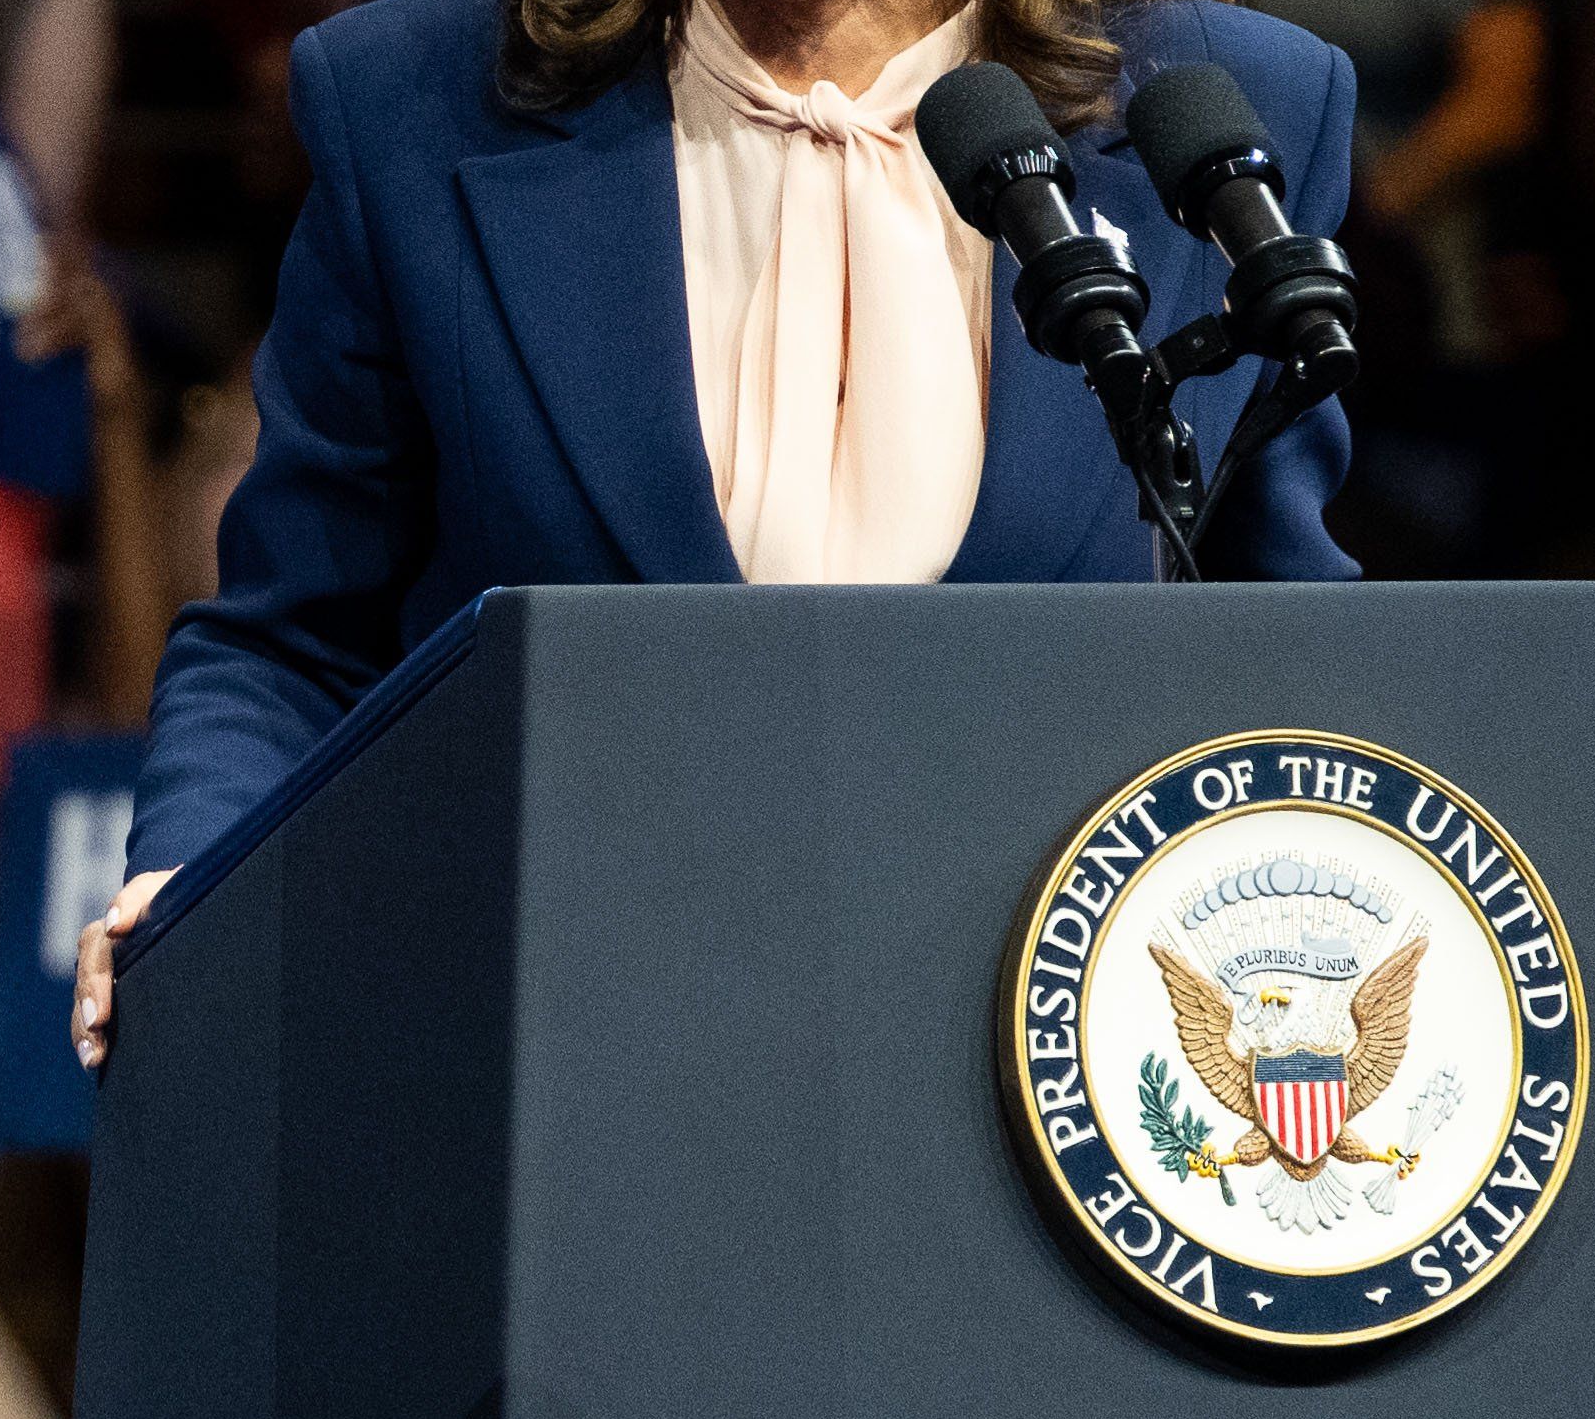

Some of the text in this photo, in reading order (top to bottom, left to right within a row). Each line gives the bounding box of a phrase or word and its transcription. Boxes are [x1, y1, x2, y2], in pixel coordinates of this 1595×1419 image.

[1026, 754, 1572, 1314] VICE PRESIDENT OF THE UNITED STATES
[1223, 948, 1360, 979] E PLURIBUS UNUM
